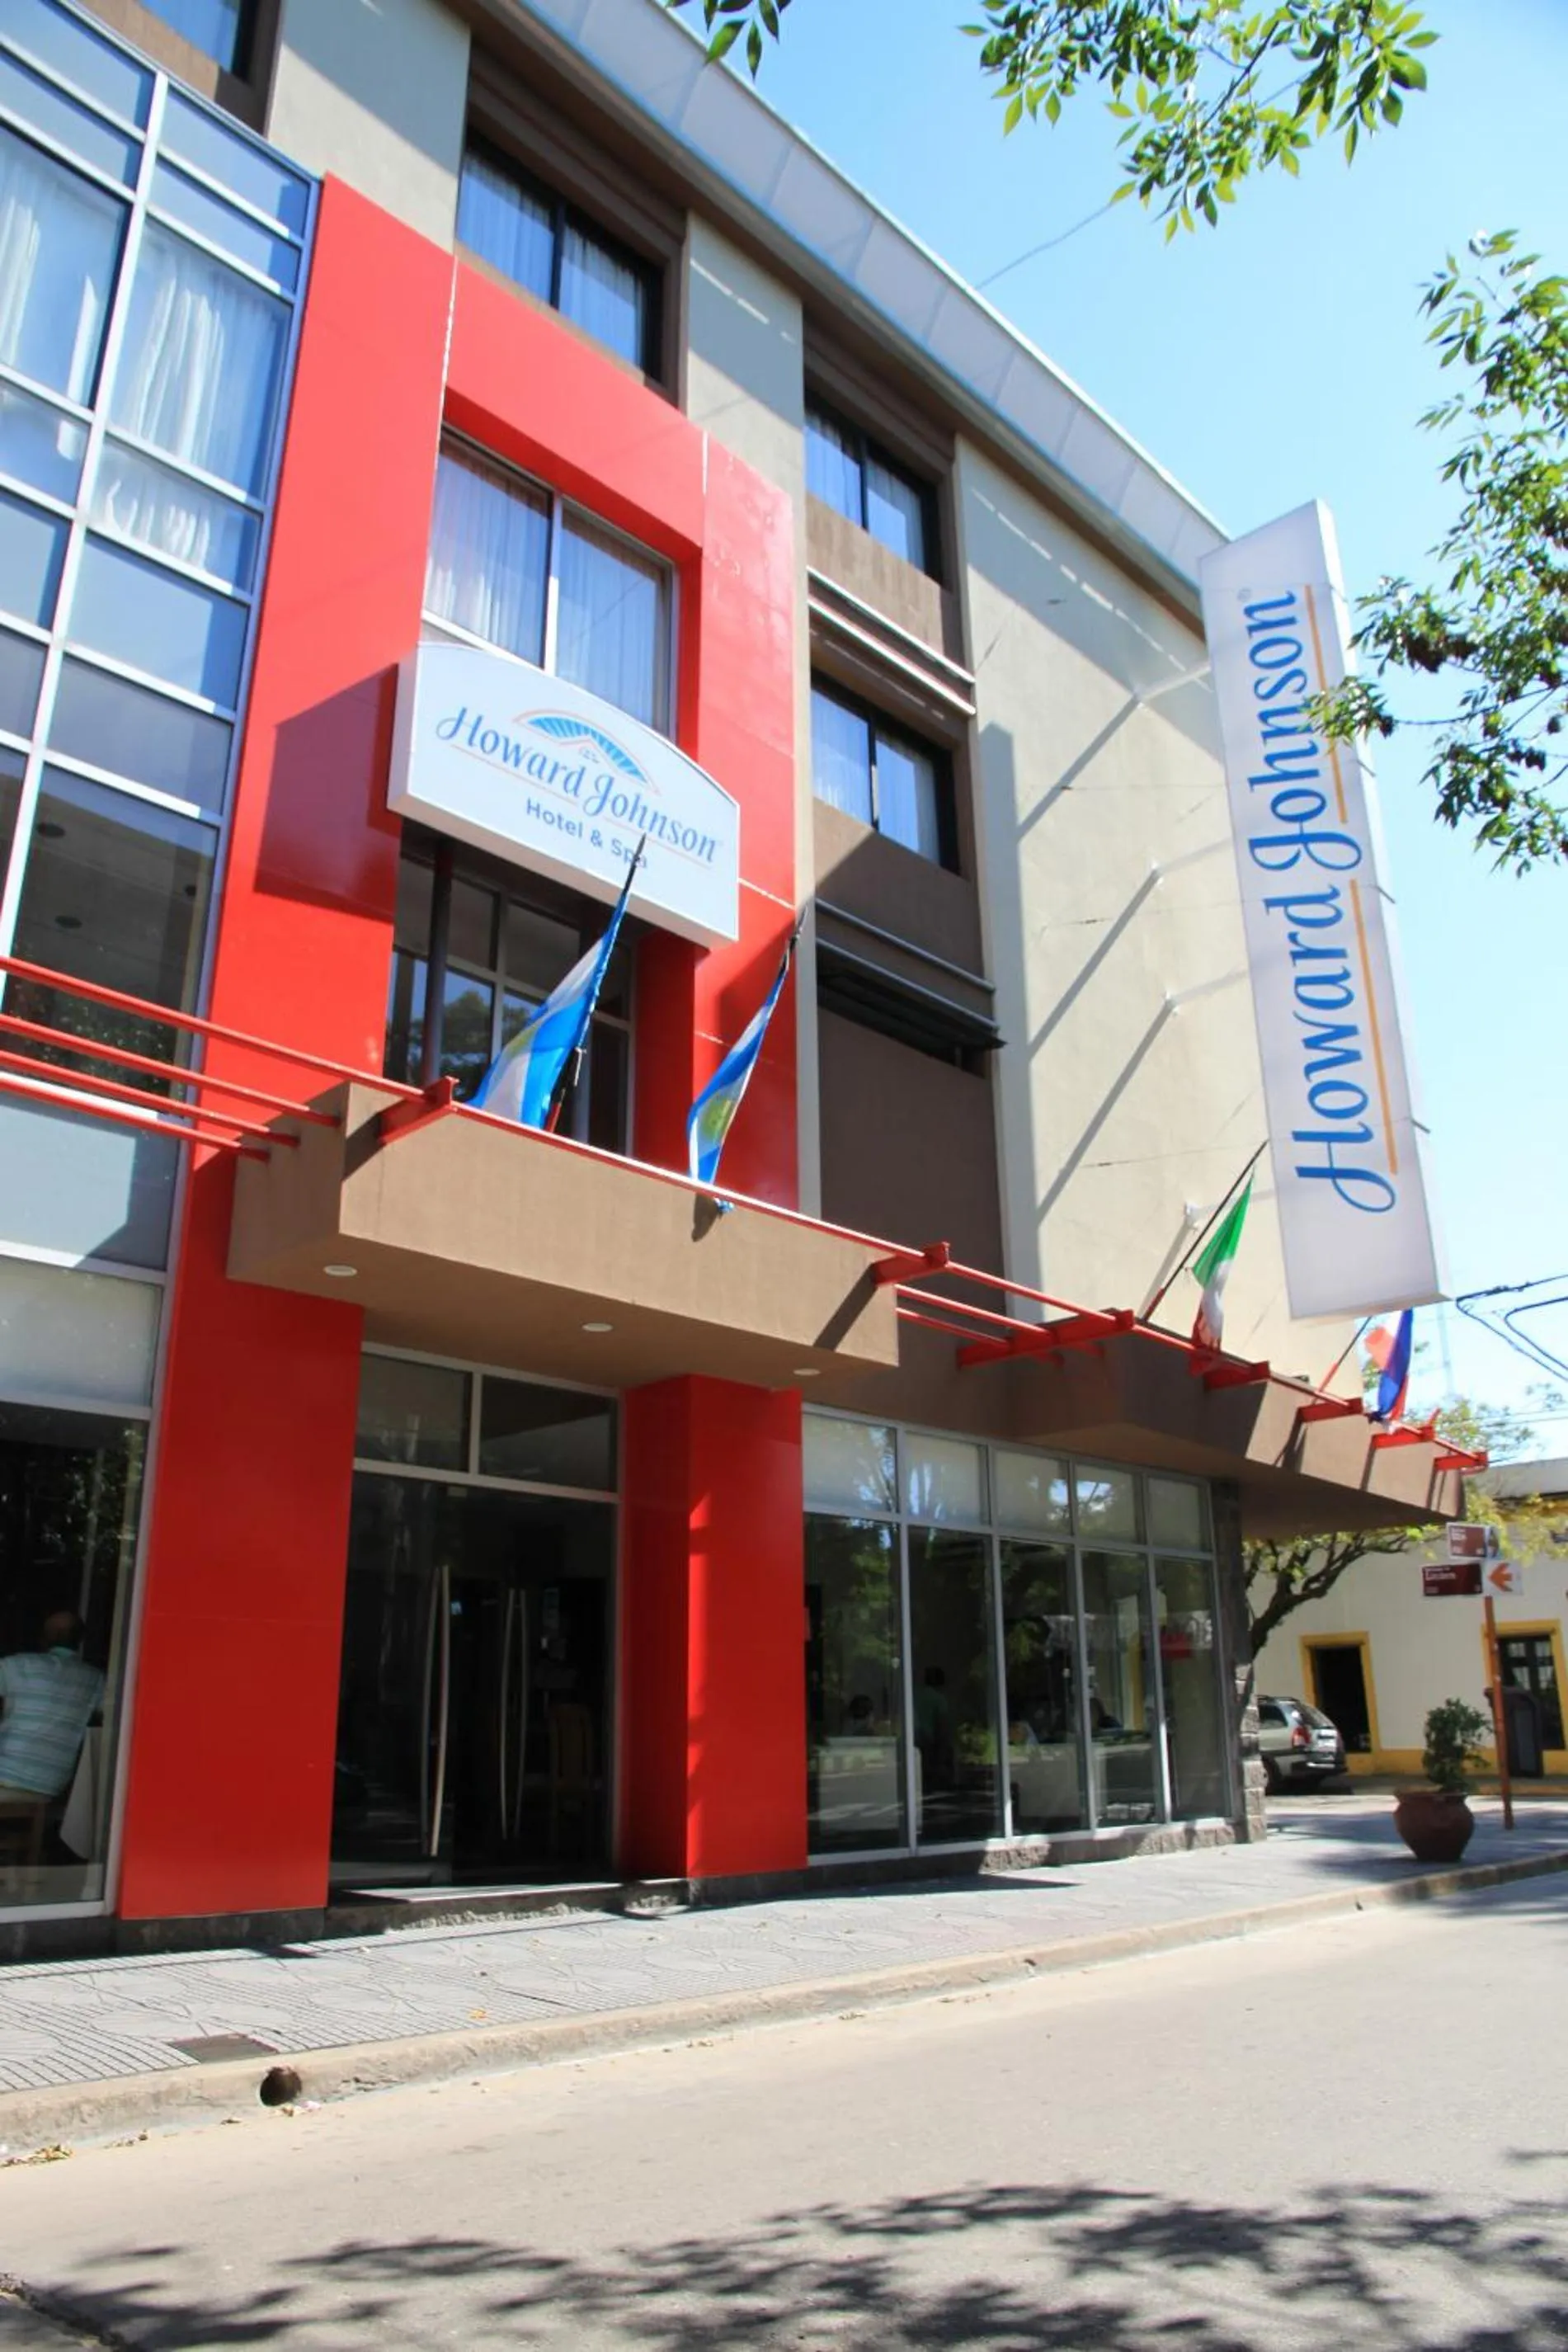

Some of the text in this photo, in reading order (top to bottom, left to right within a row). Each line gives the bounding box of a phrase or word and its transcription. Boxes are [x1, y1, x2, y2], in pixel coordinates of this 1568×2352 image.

[436, 708, 721, 863] Howard Johnson
[526, 798, 583, 838] Hotel
[590, 828, 603, 849] &
[1243, 590, 1396, 1214] Howard Johnson
